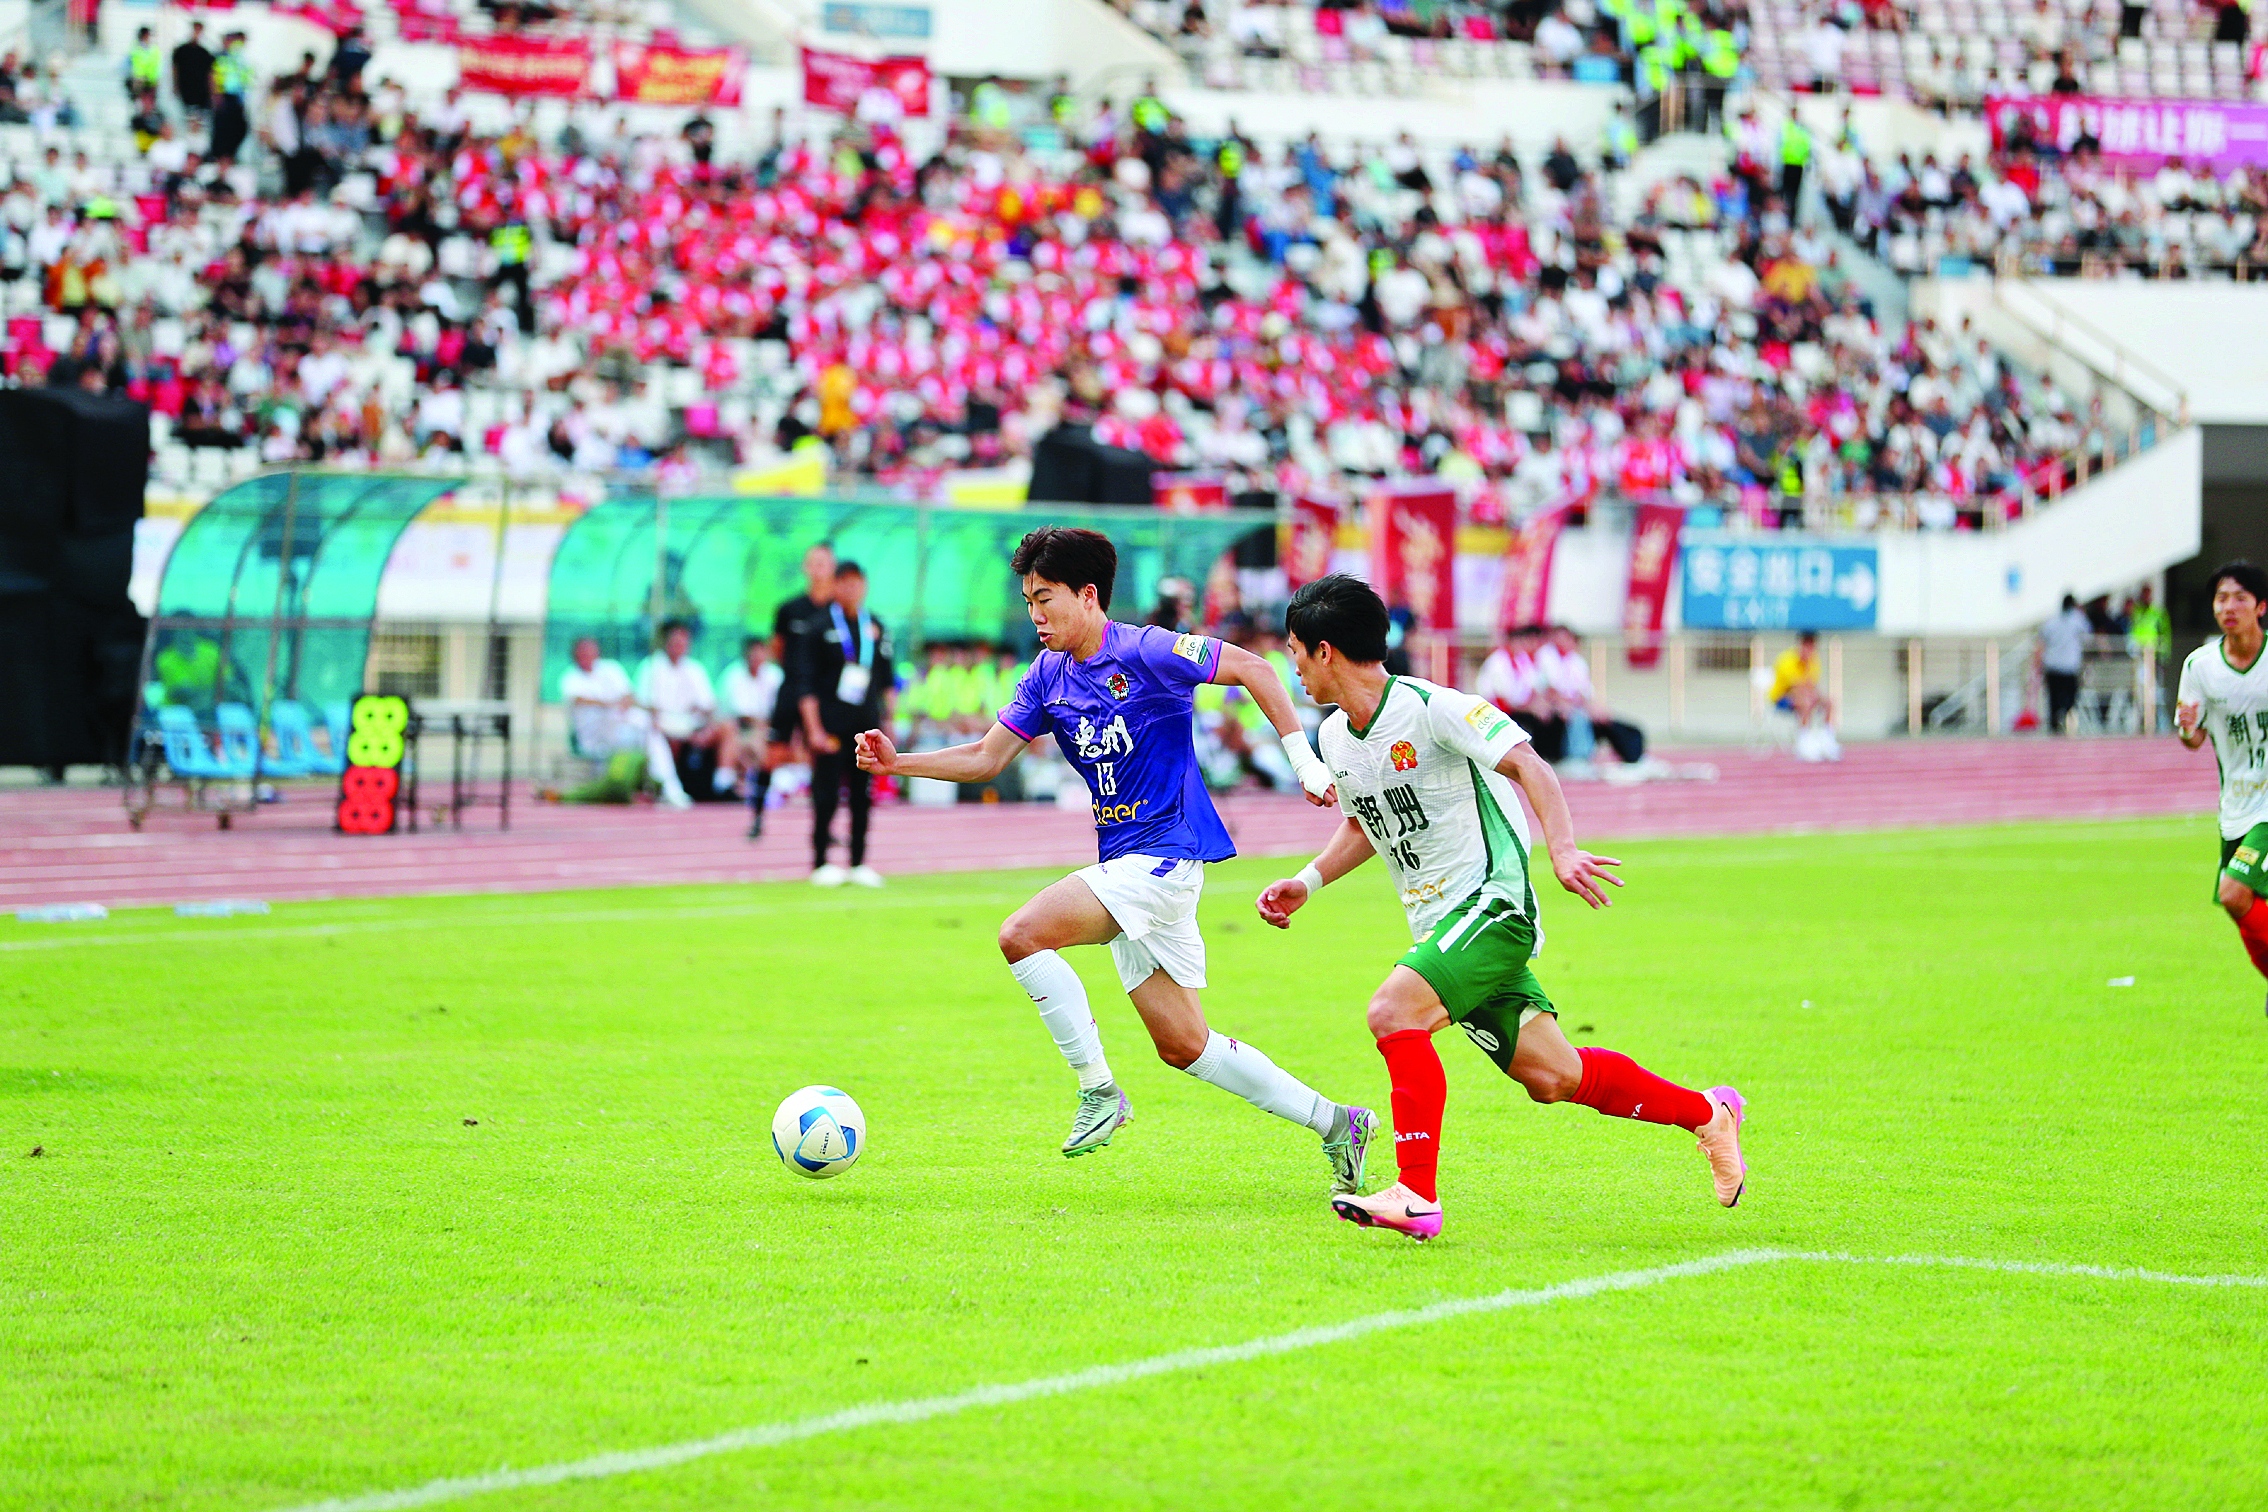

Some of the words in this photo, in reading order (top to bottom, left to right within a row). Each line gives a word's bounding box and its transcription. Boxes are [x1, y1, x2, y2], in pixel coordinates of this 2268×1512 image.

[1094, 762, 1118, 796] 13
[1351, 783, 1430, 841] 潮州
[1389, 839, 1421, 873] 16
